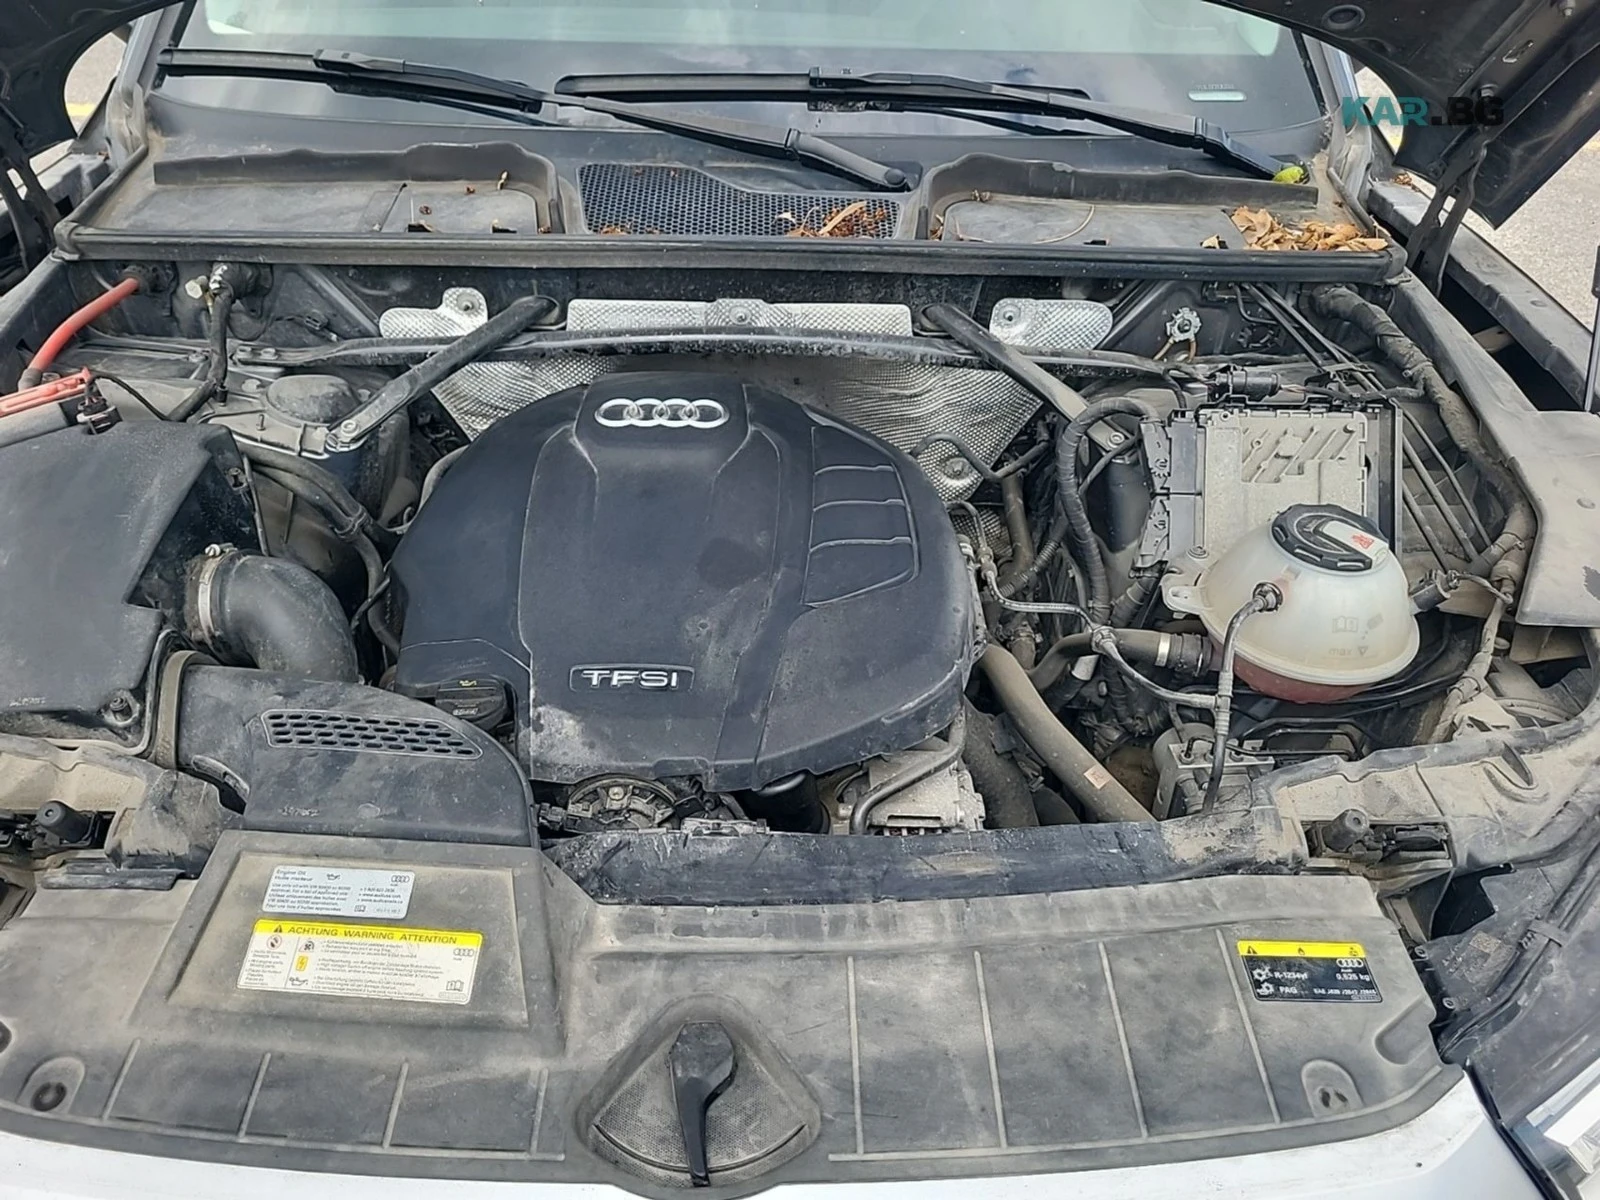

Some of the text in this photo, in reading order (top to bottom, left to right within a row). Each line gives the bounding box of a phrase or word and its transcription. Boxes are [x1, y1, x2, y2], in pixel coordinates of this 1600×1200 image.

[1328, 648, 1352, 656] max
[582, 670, 678, 687] TFSI
[288, 926, 338, 936] ACHTUNG
[343, 929, 395, 940] WARNING
[399, 933, 458, 944] ATTENTION
[1278, 986, 1299, 994] PAG
